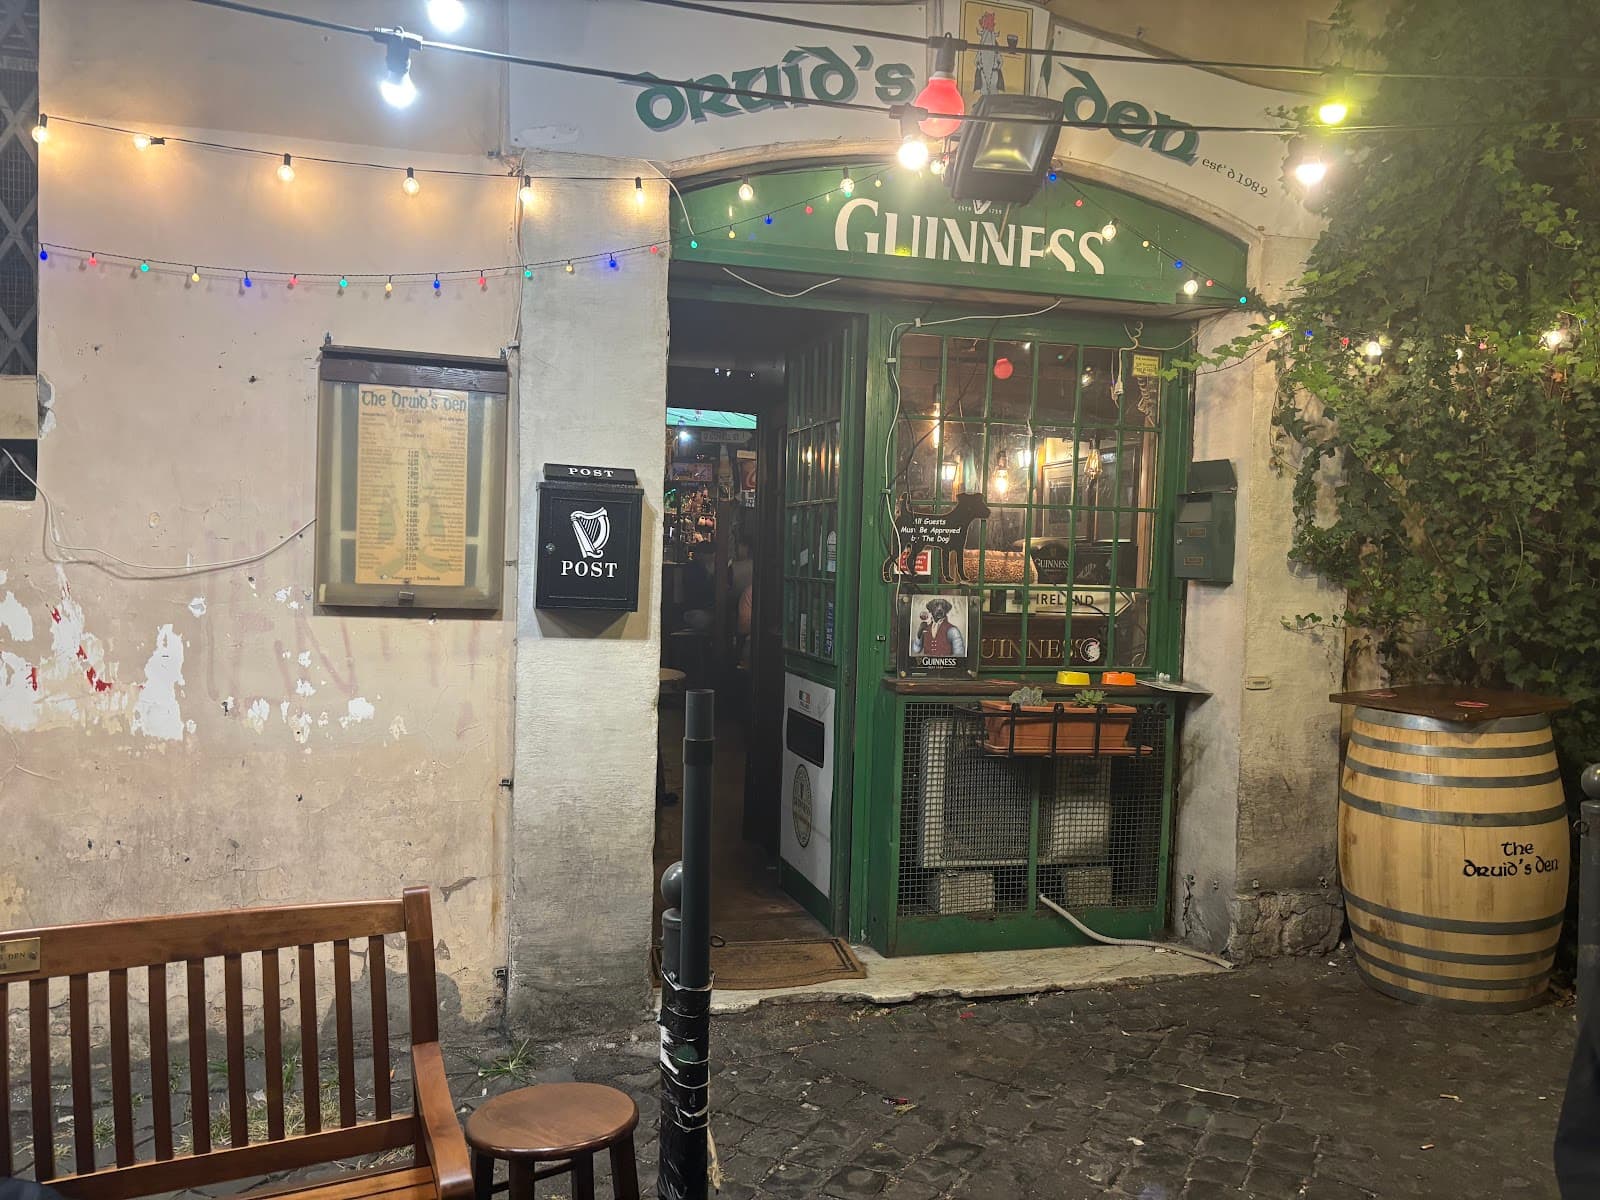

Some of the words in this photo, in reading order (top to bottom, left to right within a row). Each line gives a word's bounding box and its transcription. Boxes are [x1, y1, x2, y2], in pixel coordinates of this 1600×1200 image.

[1236, 173, 1268, 198] 1982
[834, 198, 1105, 275] GUINNESS
[361, 390, 386, 407] The
[567, 467, 614, 478] POST
[923, 518, 946, 526] Guests
[930, 527, 961, 536] Approved
[937, 535, 950, 544] Dog
[560, 560, 618, 578] POST
[1036, 593, 1094, 606] IRELND
[922, 656, 957, 666] GUINNESS
